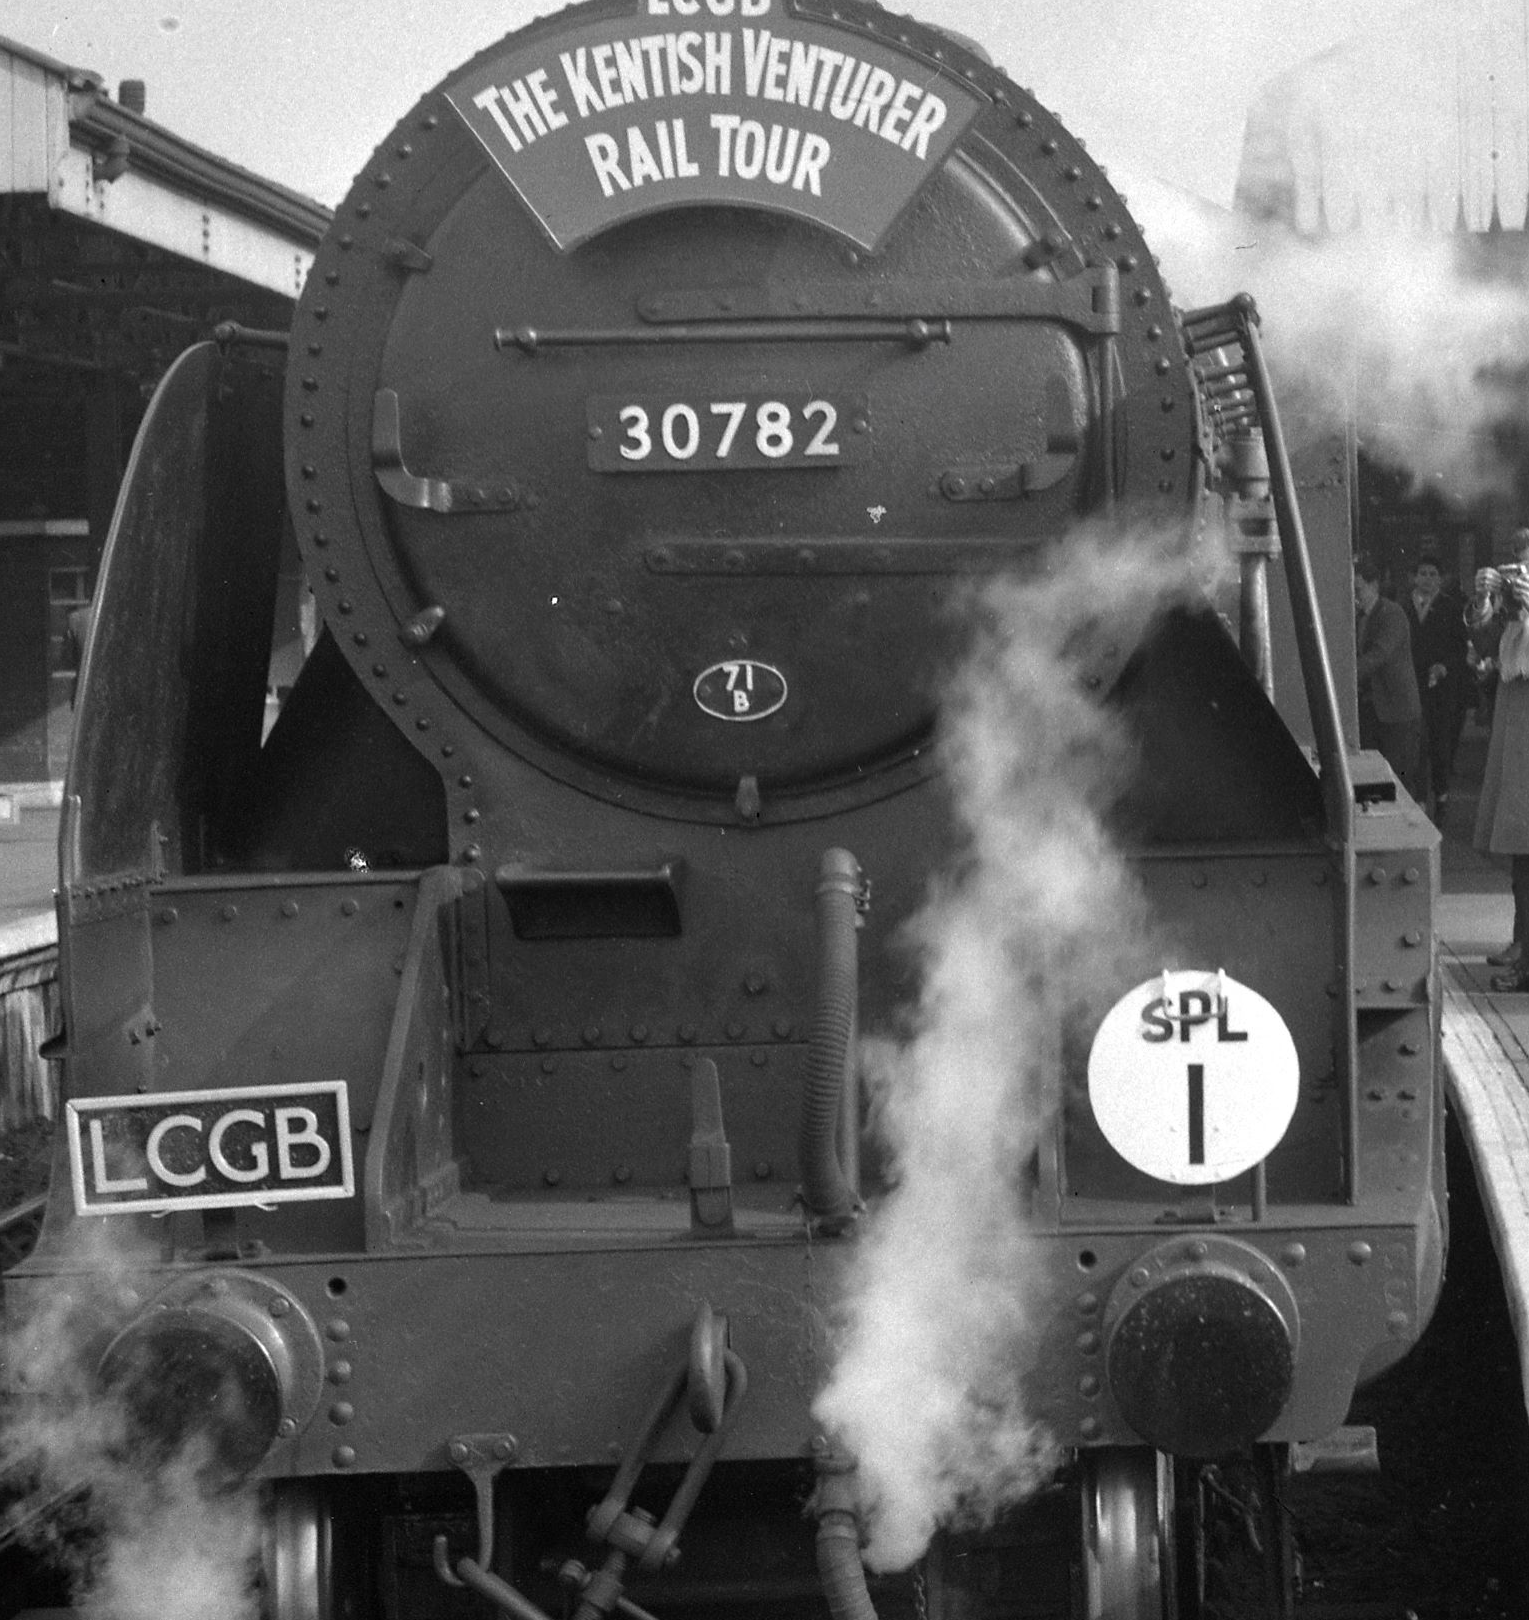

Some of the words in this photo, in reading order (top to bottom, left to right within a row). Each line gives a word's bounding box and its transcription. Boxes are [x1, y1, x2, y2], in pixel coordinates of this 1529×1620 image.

[472, 67, 570, 154] THE
[559, 30, 732, 118] KENTISH
[742, 27, 948, 161] VENTURER
[584, 118, 700, 198] RAIL
[710, 113, 832, 198] TOUR
[620, 400, 840, 460] 30782
[721, 664, 754, 692] 71
[733, 689, 750, 713] B
[1141, 989, 1249, 1044] SPL
[89, 1106, 331, 1194] LCGB
